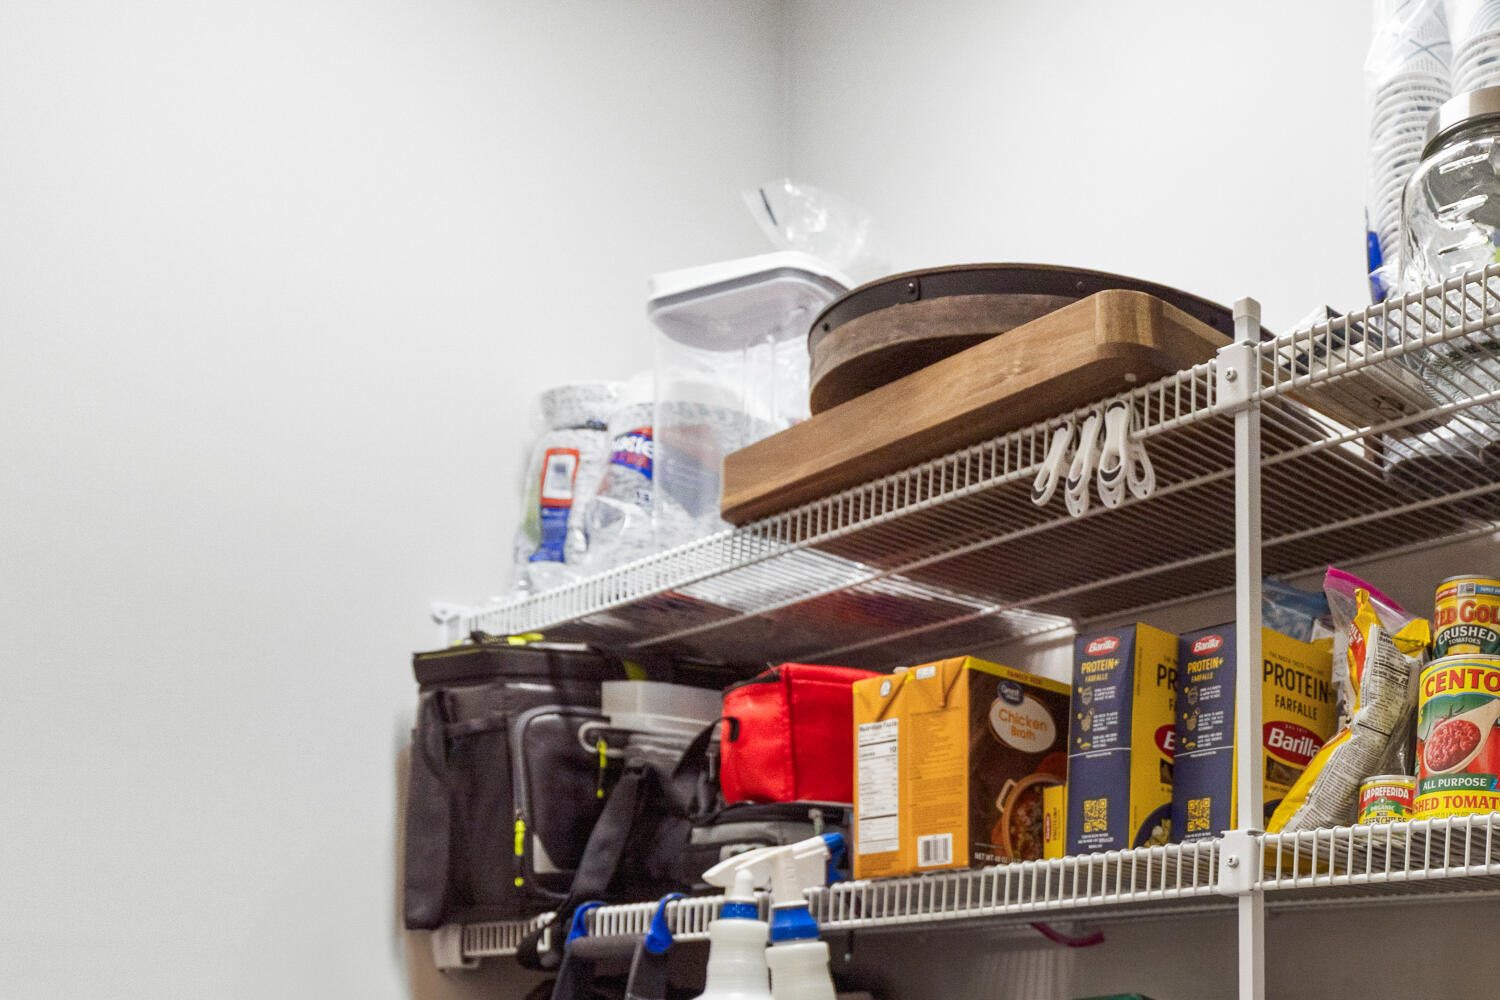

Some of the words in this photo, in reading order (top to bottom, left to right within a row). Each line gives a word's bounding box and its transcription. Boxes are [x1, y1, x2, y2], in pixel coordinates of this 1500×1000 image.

[1434, 606, 1457, 630] RED
[1438, 626, 1497, 645] CRUSHED
[1088, 639, 1117, 652] Barilla
[1193, 638, 1220, 653] Barilla
[1081, 658, 1119, 674] PROTEIN+
[1187, 657, 1224, 673] PROTEIN+
[1275, 694, 1318, 721] FARFALLE
[998, 708, 1048, 731] Chicken
[1010, 726, 1036, 741] Broth
[1268, 727, 1322, 758] Barilla
[1422, 779, 1436, 790] ALL
[1438, 777, 1487, 788] PURPOSE
[1370, 804, 1395, 812] ORGANIC
